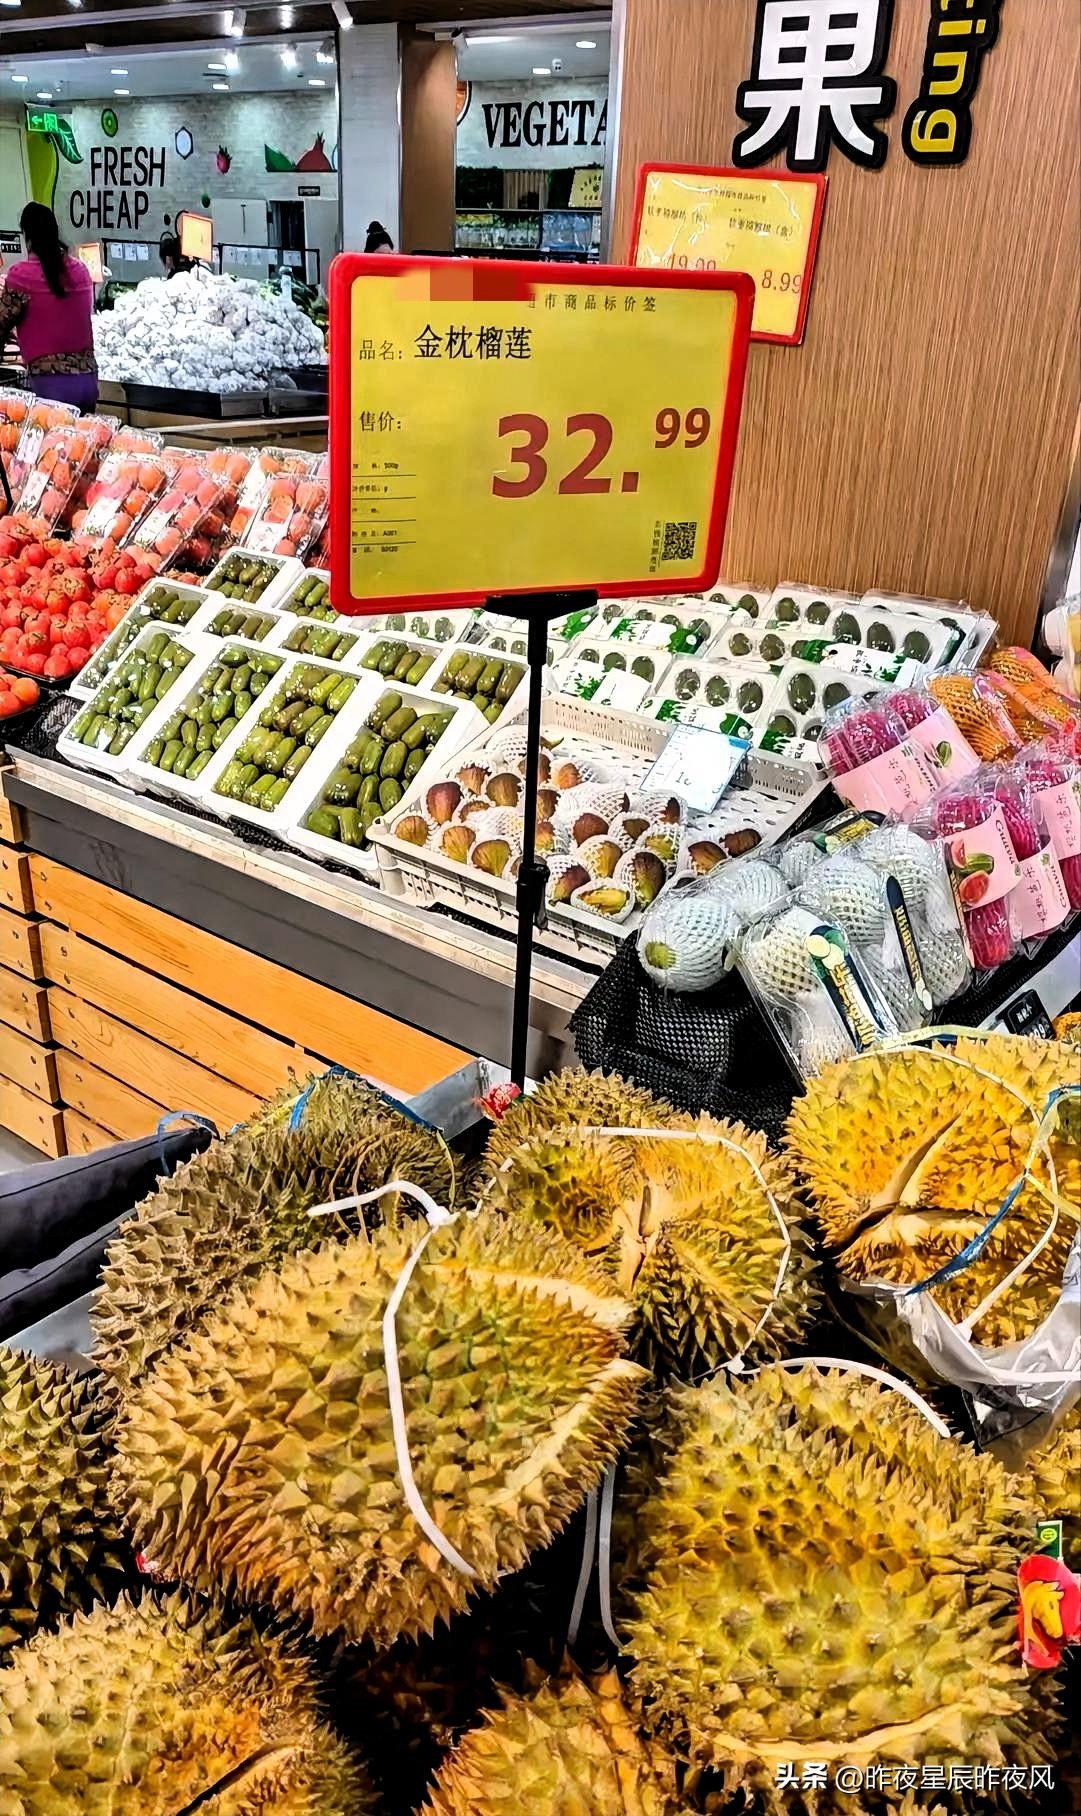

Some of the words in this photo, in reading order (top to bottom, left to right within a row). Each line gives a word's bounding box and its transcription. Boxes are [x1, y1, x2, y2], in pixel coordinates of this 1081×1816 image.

[740, 0, 883, 160] 果
[90, 146, 166, 187] FRESH
[69, 190, 149, 229] CHEAP
[762, 270, 801, 294] 8.99
[414, 324, 532, 361] 金枕榴莲
